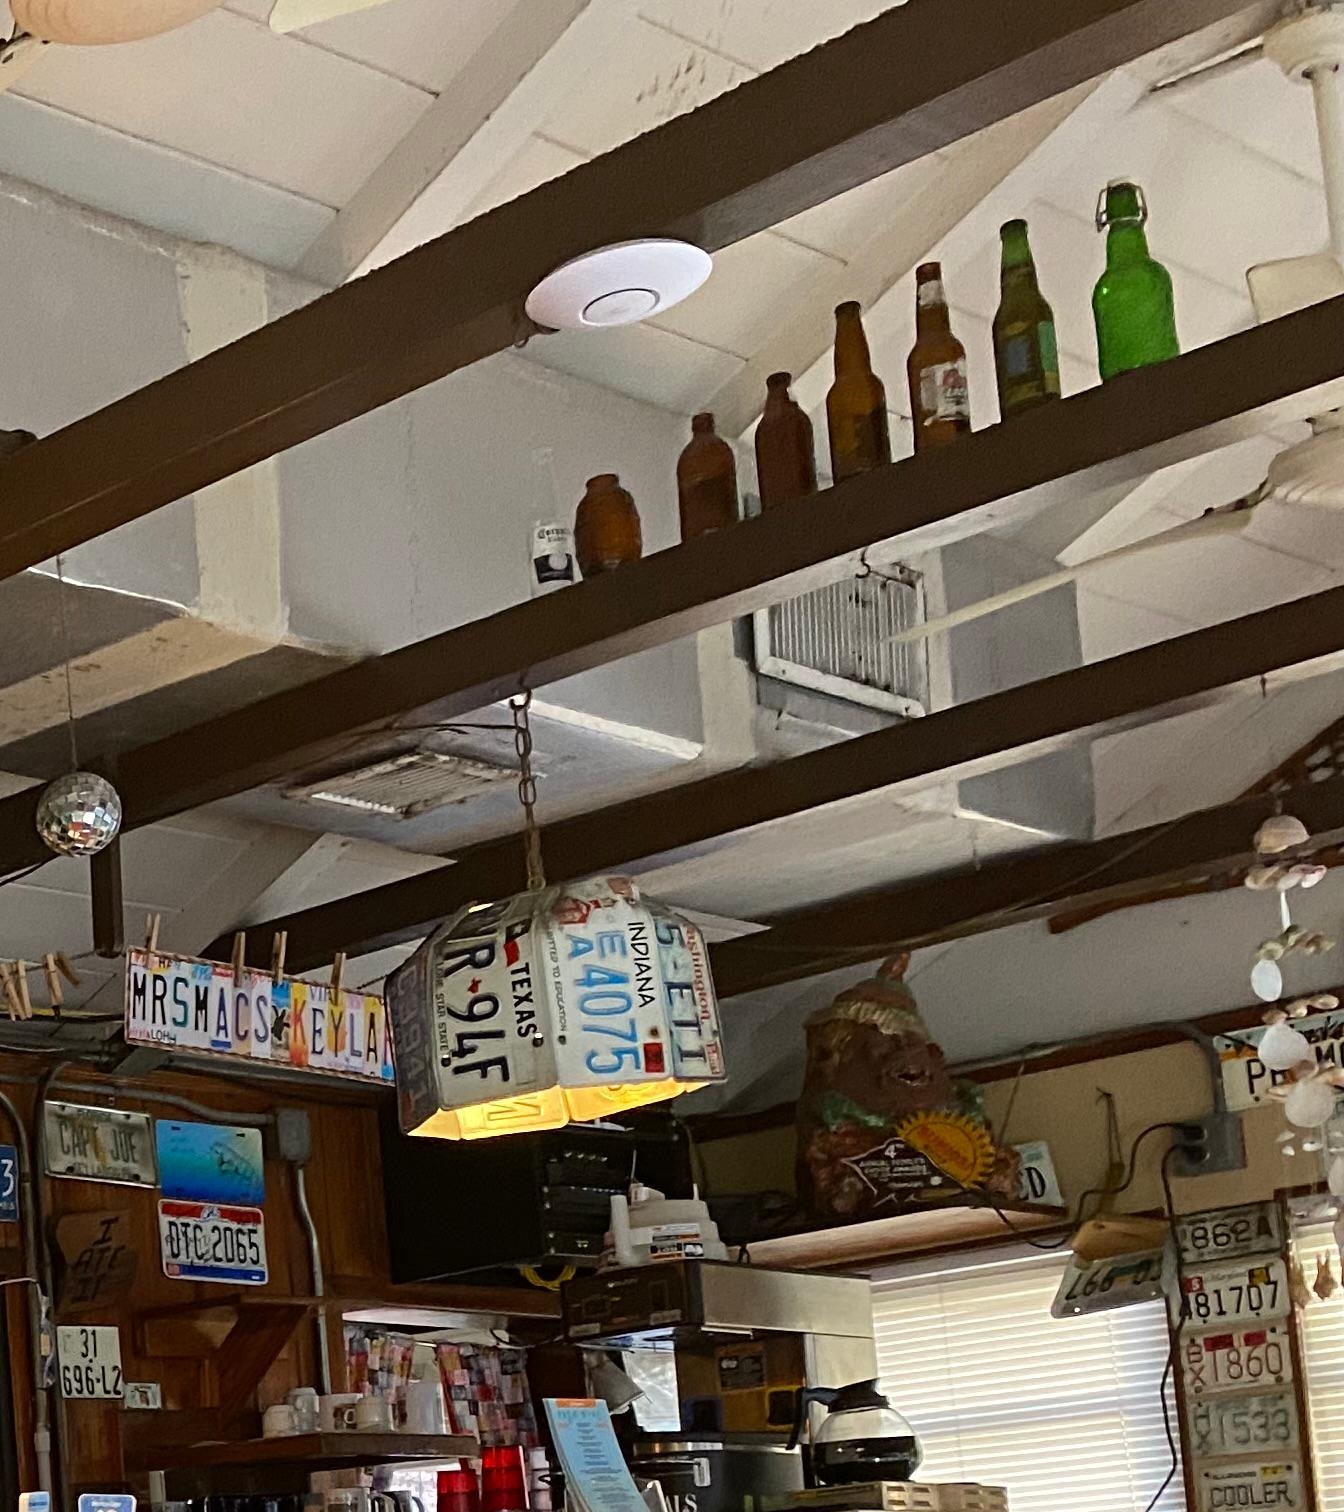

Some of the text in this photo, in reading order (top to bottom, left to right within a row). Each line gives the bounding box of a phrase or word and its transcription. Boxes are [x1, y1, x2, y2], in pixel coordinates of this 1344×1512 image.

[510, 962, 539, 1039] TEXAS
[627, 922, 656, 1008] INDIANA
[132, 971, 269, 1044] MRSMACS
[574, 963, 642, 1076] 4075
[211, 1225, 261, 1266] 2065
[80, 1328, 98, 1359] 31
[1209, 1480, 1294, 1509] COOLER
